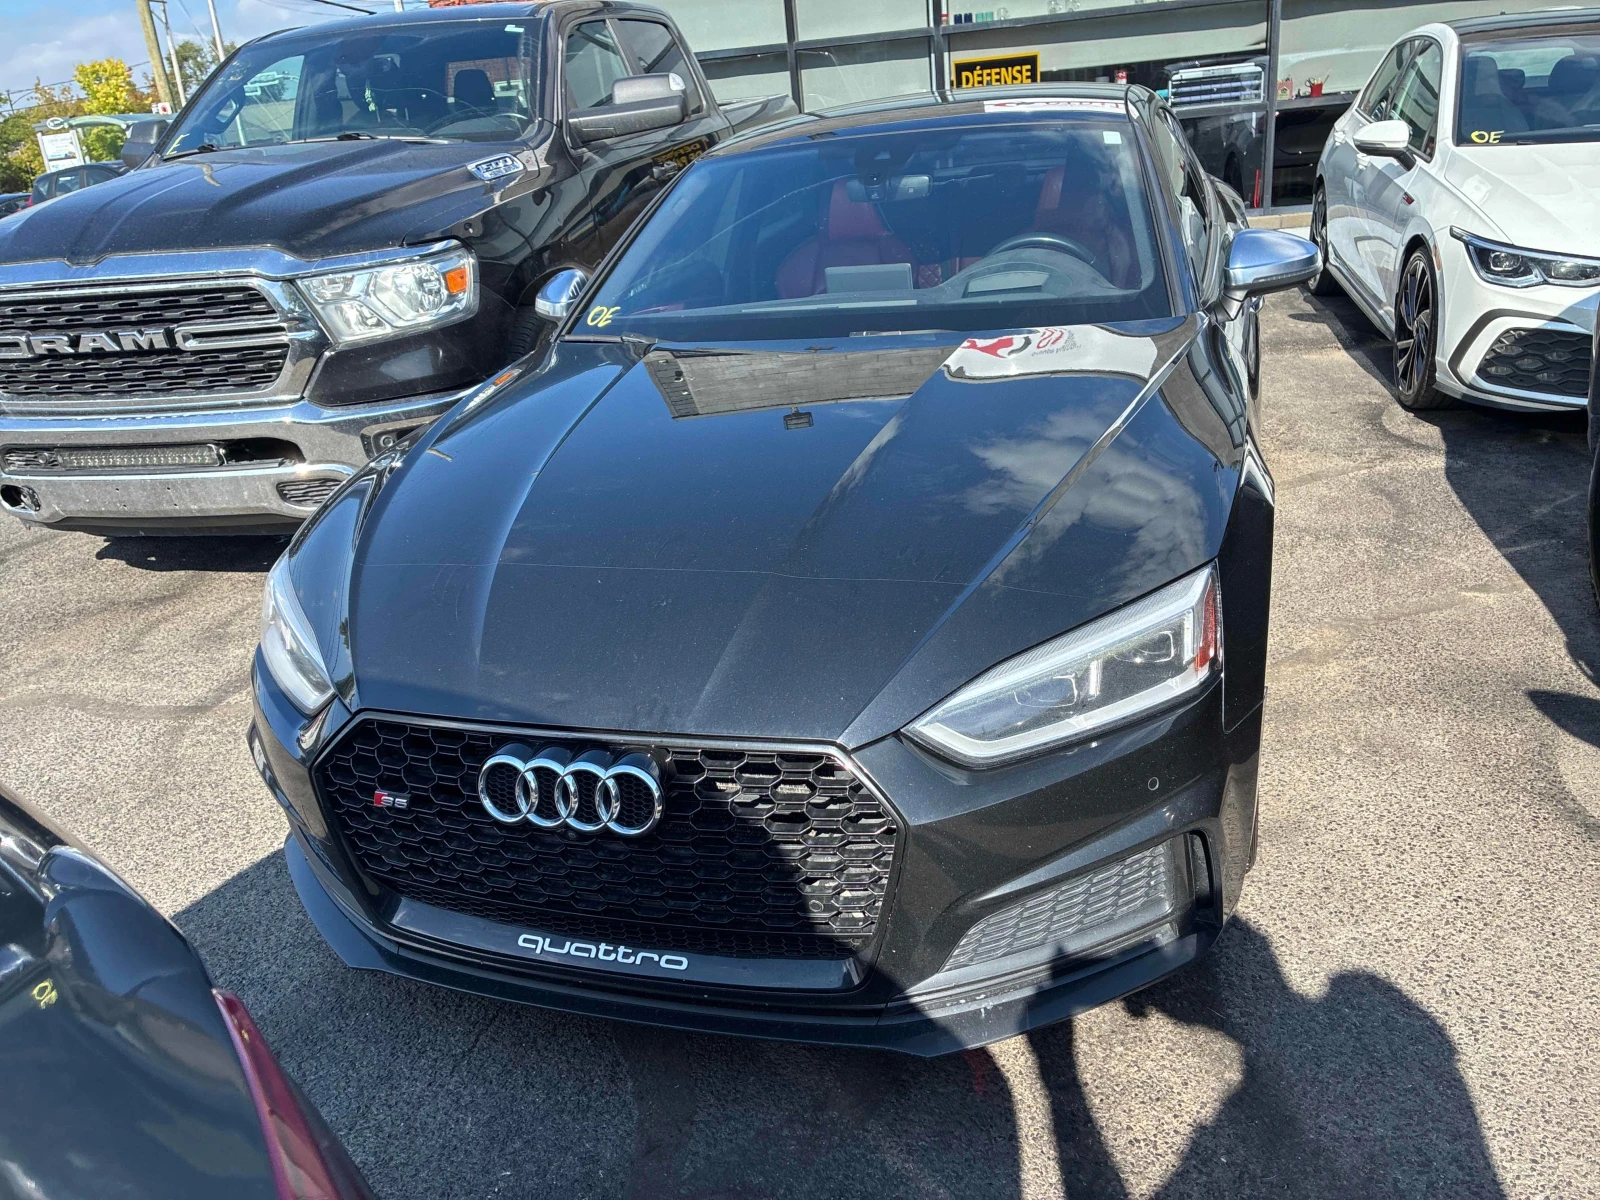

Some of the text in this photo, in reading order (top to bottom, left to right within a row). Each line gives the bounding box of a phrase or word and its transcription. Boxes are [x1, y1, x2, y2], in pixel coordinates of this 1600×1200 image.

[961, 65, 1031, 88] DÉFENSE
[30, 329, 170, 355] RAM
[517, 933, 689, 971] quattro
